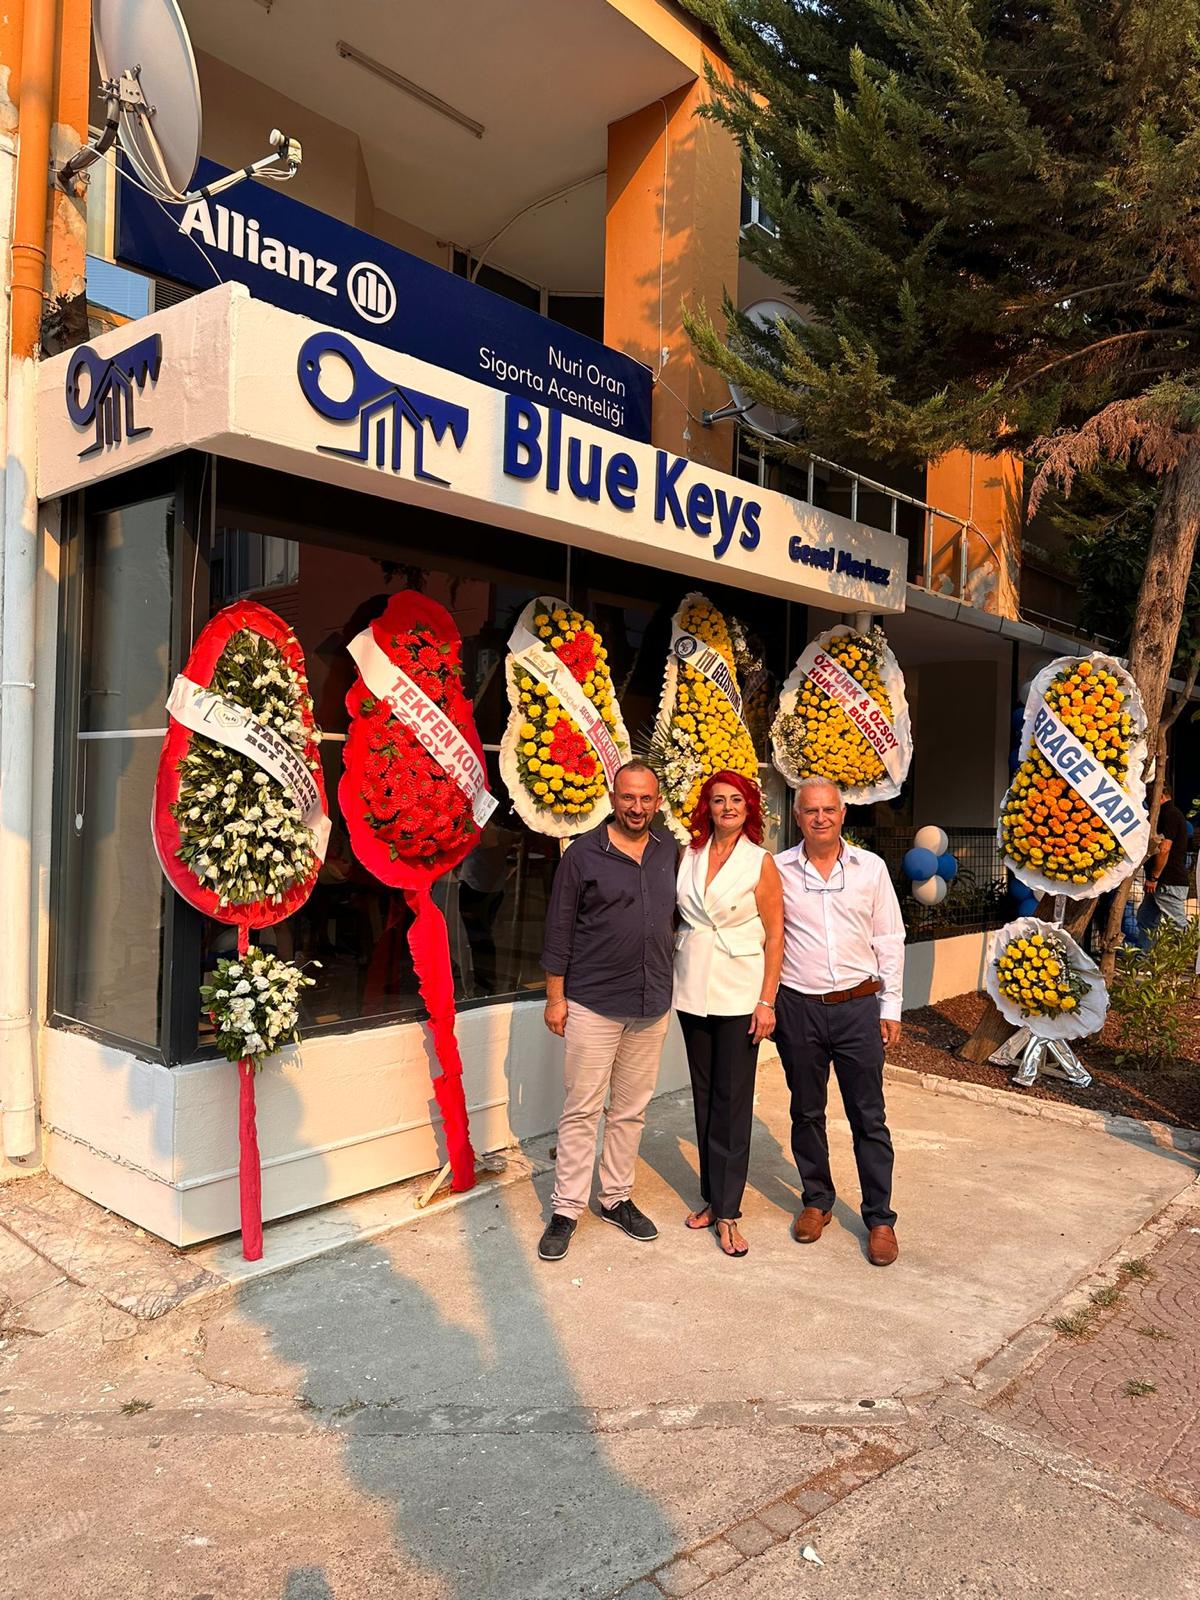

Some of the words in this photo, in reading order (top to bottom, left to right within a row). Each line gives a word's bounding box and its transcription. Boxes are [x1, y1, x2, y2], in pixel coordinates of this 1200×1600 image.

[177, 191, 338, 297] Allianz
[479, 346, 544, 392] Sigorta
[548, 377, 625, 428] Acenteliği
[548, 345, 583, 379] Nuri
[587, 364, 626, 397] Oran
[503, 393, 639, 512] Blue
[653, 449, 762, 560] Keys
[788, 535, 836, 573] Genel
[836, 550, 891, 586] Merkez
[694, 647, 720, 674] İTÜ
[813, 652, 862, 702] ÖZTÜRK
[859, 699, 871, 712] &
[868, 709, 900, 750] ÖZSOY
[382, 694, 445, 758] ÖZSOY
[390, 676, 458, 749] TEKFEN
[807, 667, 851, 708] HUKUK
[847, 705, 889, 756] BÜROSU
[251, 720, 318, 804] TAÇYILDIZ
[1034, 707, 1097, 785] BRAGE
[1088, 776, 1142, 838] YAPI
